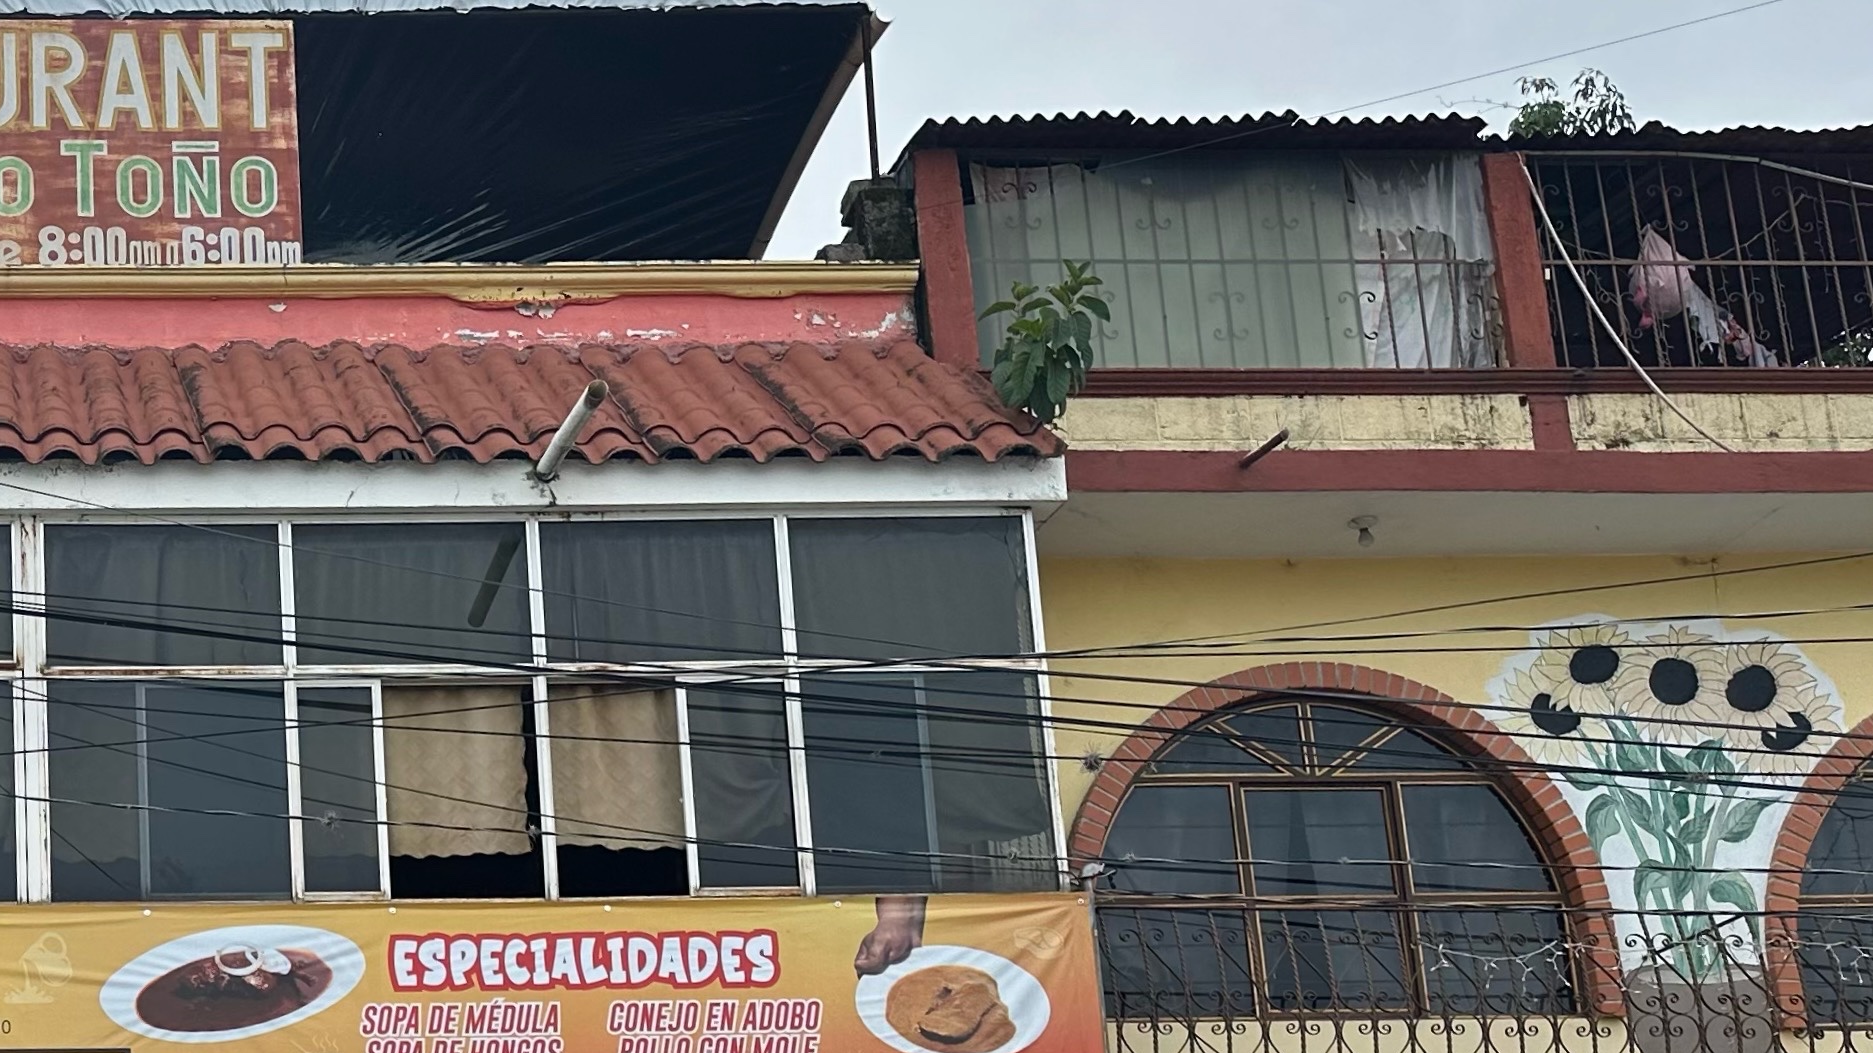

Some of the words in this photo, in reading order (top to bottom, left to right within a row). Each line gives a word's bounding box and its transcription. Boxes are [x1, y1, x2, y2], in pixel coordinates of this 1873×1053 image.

[60, 140, 279, 218] TOÑO
[393, 934, 776, 986] ESPECIALIDADES
[361, 1003, 421, 1035] SOPA
[427, 1003, 459, 1035] DE
[464, 998, 561, 1035] MÉDULA
[608, 1001, 699, 1033] CONEJO
[704, 1001, 737, 1032] EN
[741, 1000, 822, 1032] ADOBO
